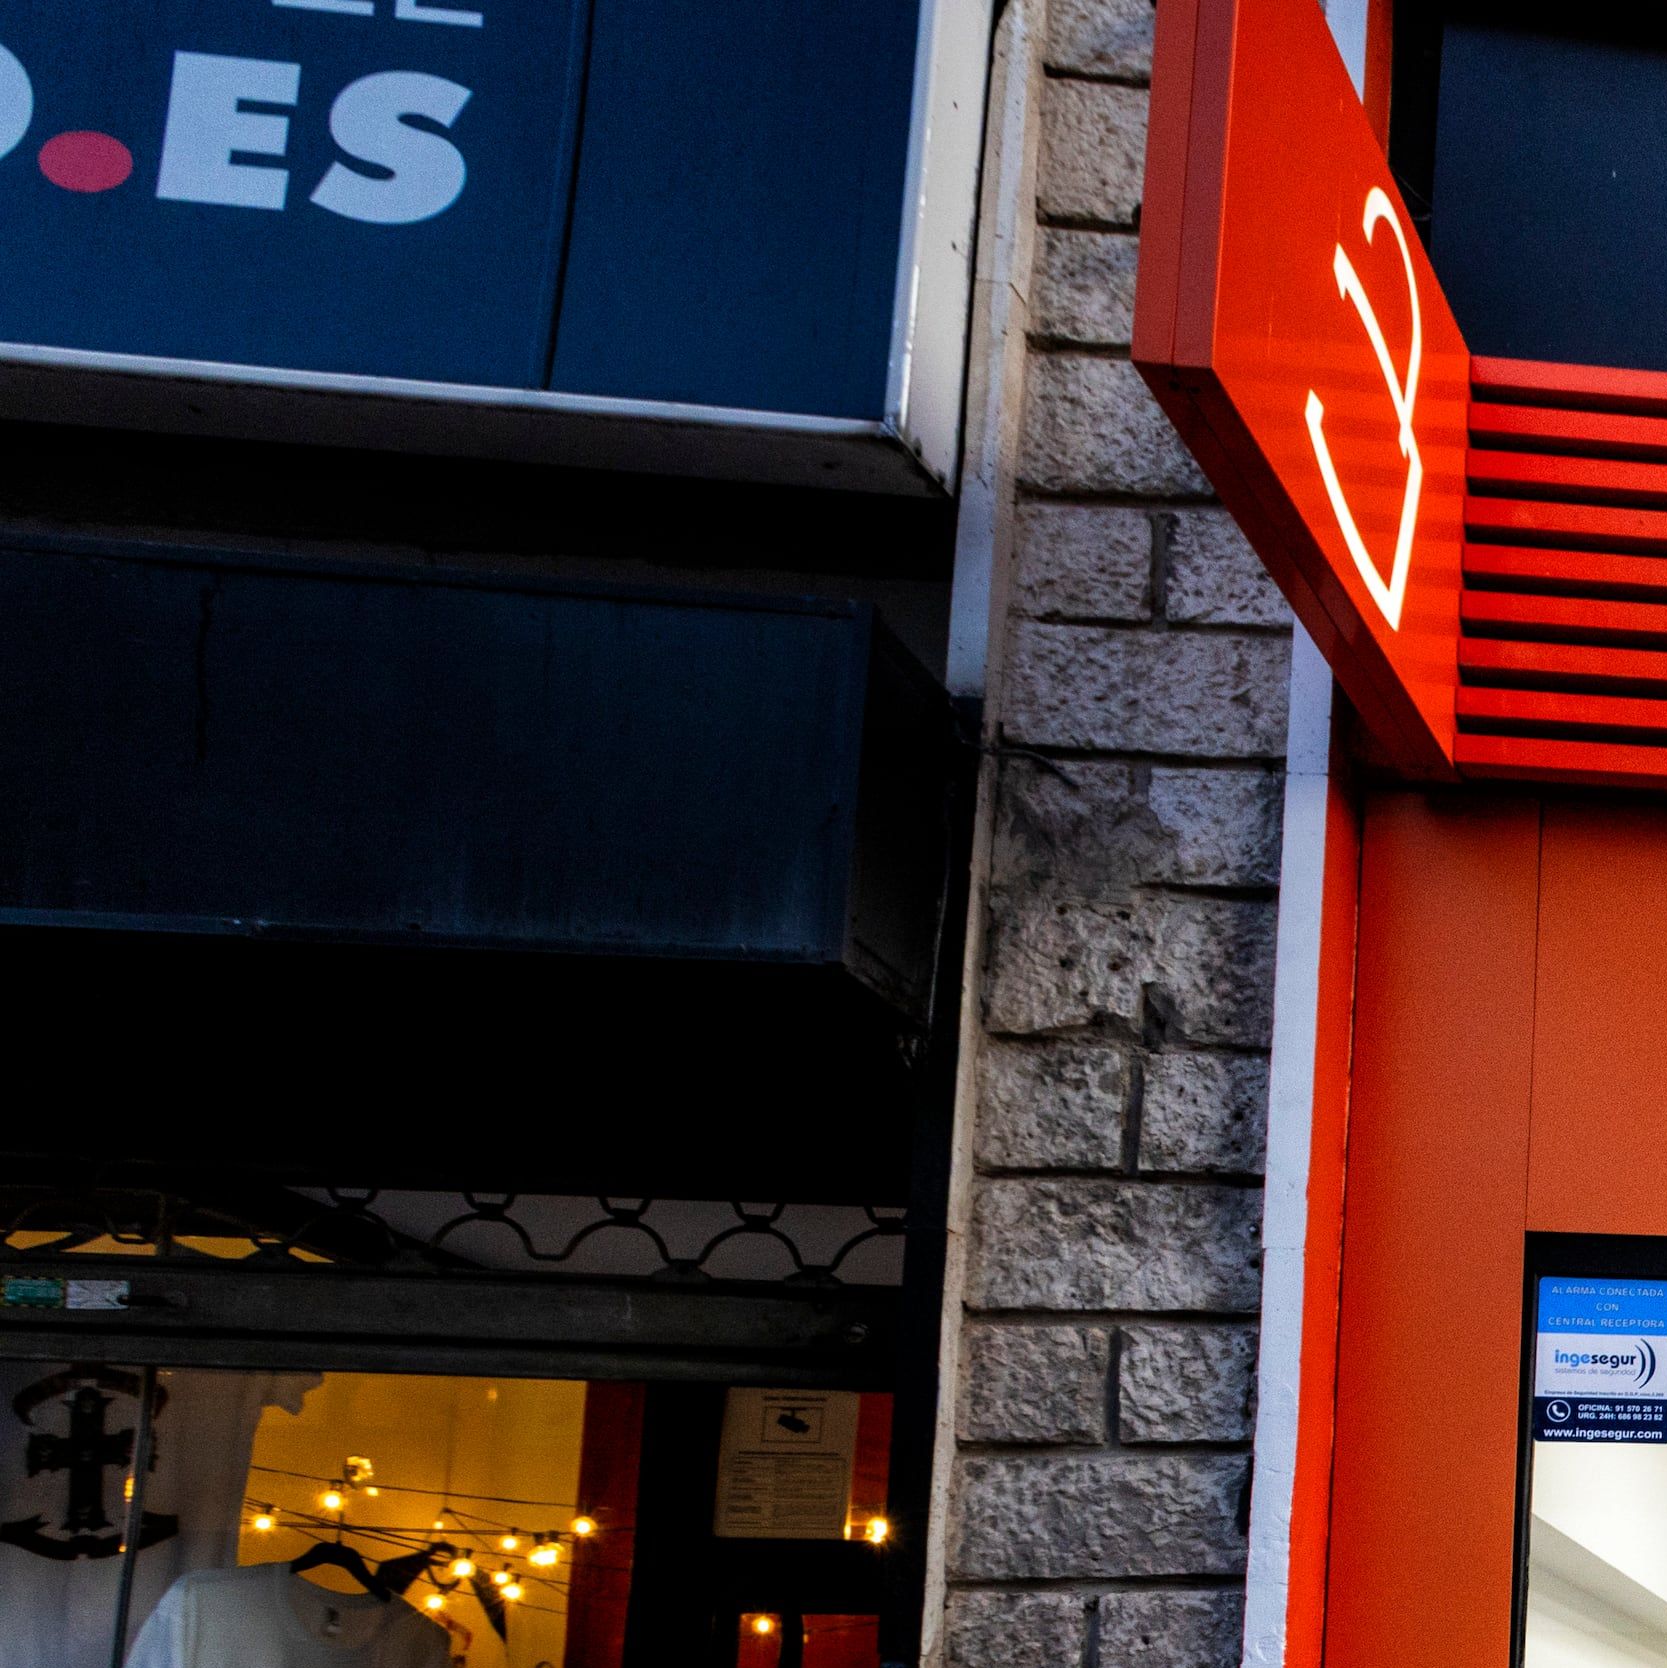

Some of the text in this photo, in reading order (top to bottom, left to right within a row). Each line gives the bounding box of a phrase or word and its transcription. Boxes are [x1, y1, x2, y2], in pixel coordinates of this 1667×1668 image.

[0, 42, 472, 225] .ES
[1551, 1286, 1664, 1297] ALARMA CONECTADA
[1596, 1303, 1619, 1312] CON
[1548, 1317, 1665, 1328] CENTRAL RECEPTORA
[1554, 1349, 1637, 1368] ingesegur
[1578, 1404, 1613, 1412] OFICINA:
[1543, 1427, 1663, 1441] www.ingesegur.com
